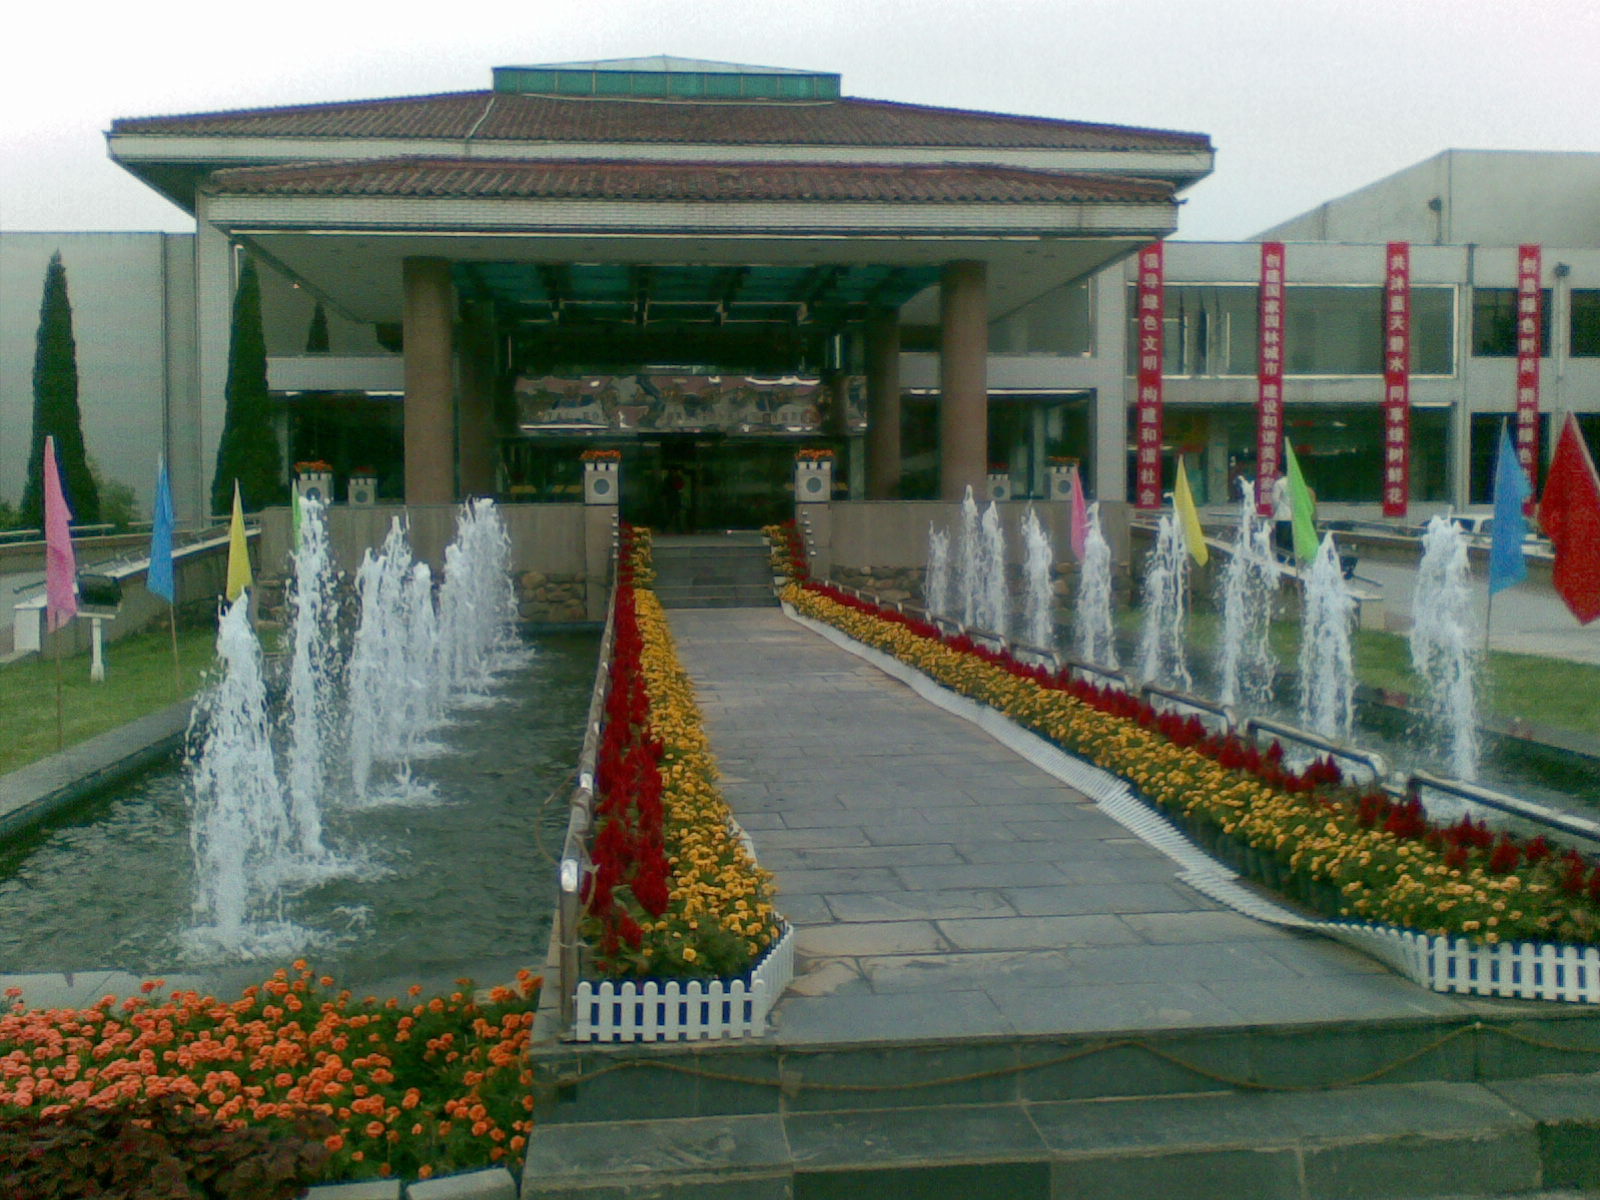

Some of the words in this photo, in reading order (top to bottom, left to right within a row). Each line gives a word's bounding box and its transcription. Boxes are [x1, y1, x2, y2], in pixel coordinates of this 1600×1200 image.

[1142, 253, 1159, 371] 倡导绿色文明
[1263, 254, 1281, 376] 创建国家园林城市
[1140, 387, 1158, 505] 构建和谐社会
